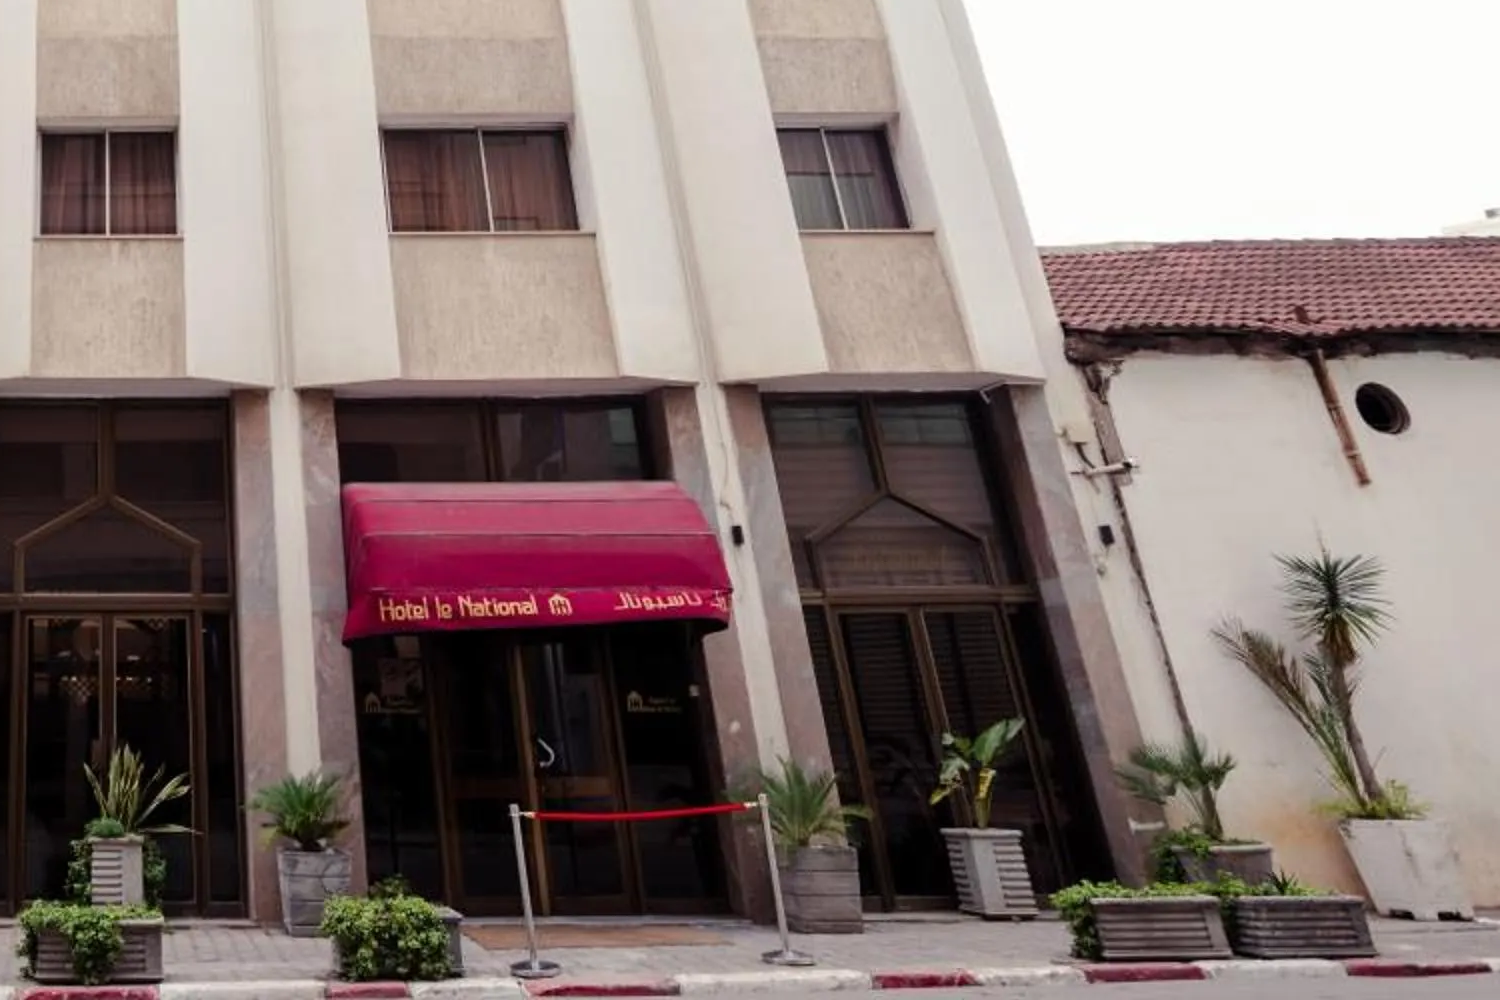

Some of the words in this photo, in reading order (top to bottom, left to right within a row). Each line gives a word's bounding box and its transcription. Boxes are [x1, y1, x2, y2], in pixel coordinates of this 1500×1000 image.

[379, 596, 429, 621] Hotel
[435, 595, 453, 619] le
[457, 594, 539, 617] National
